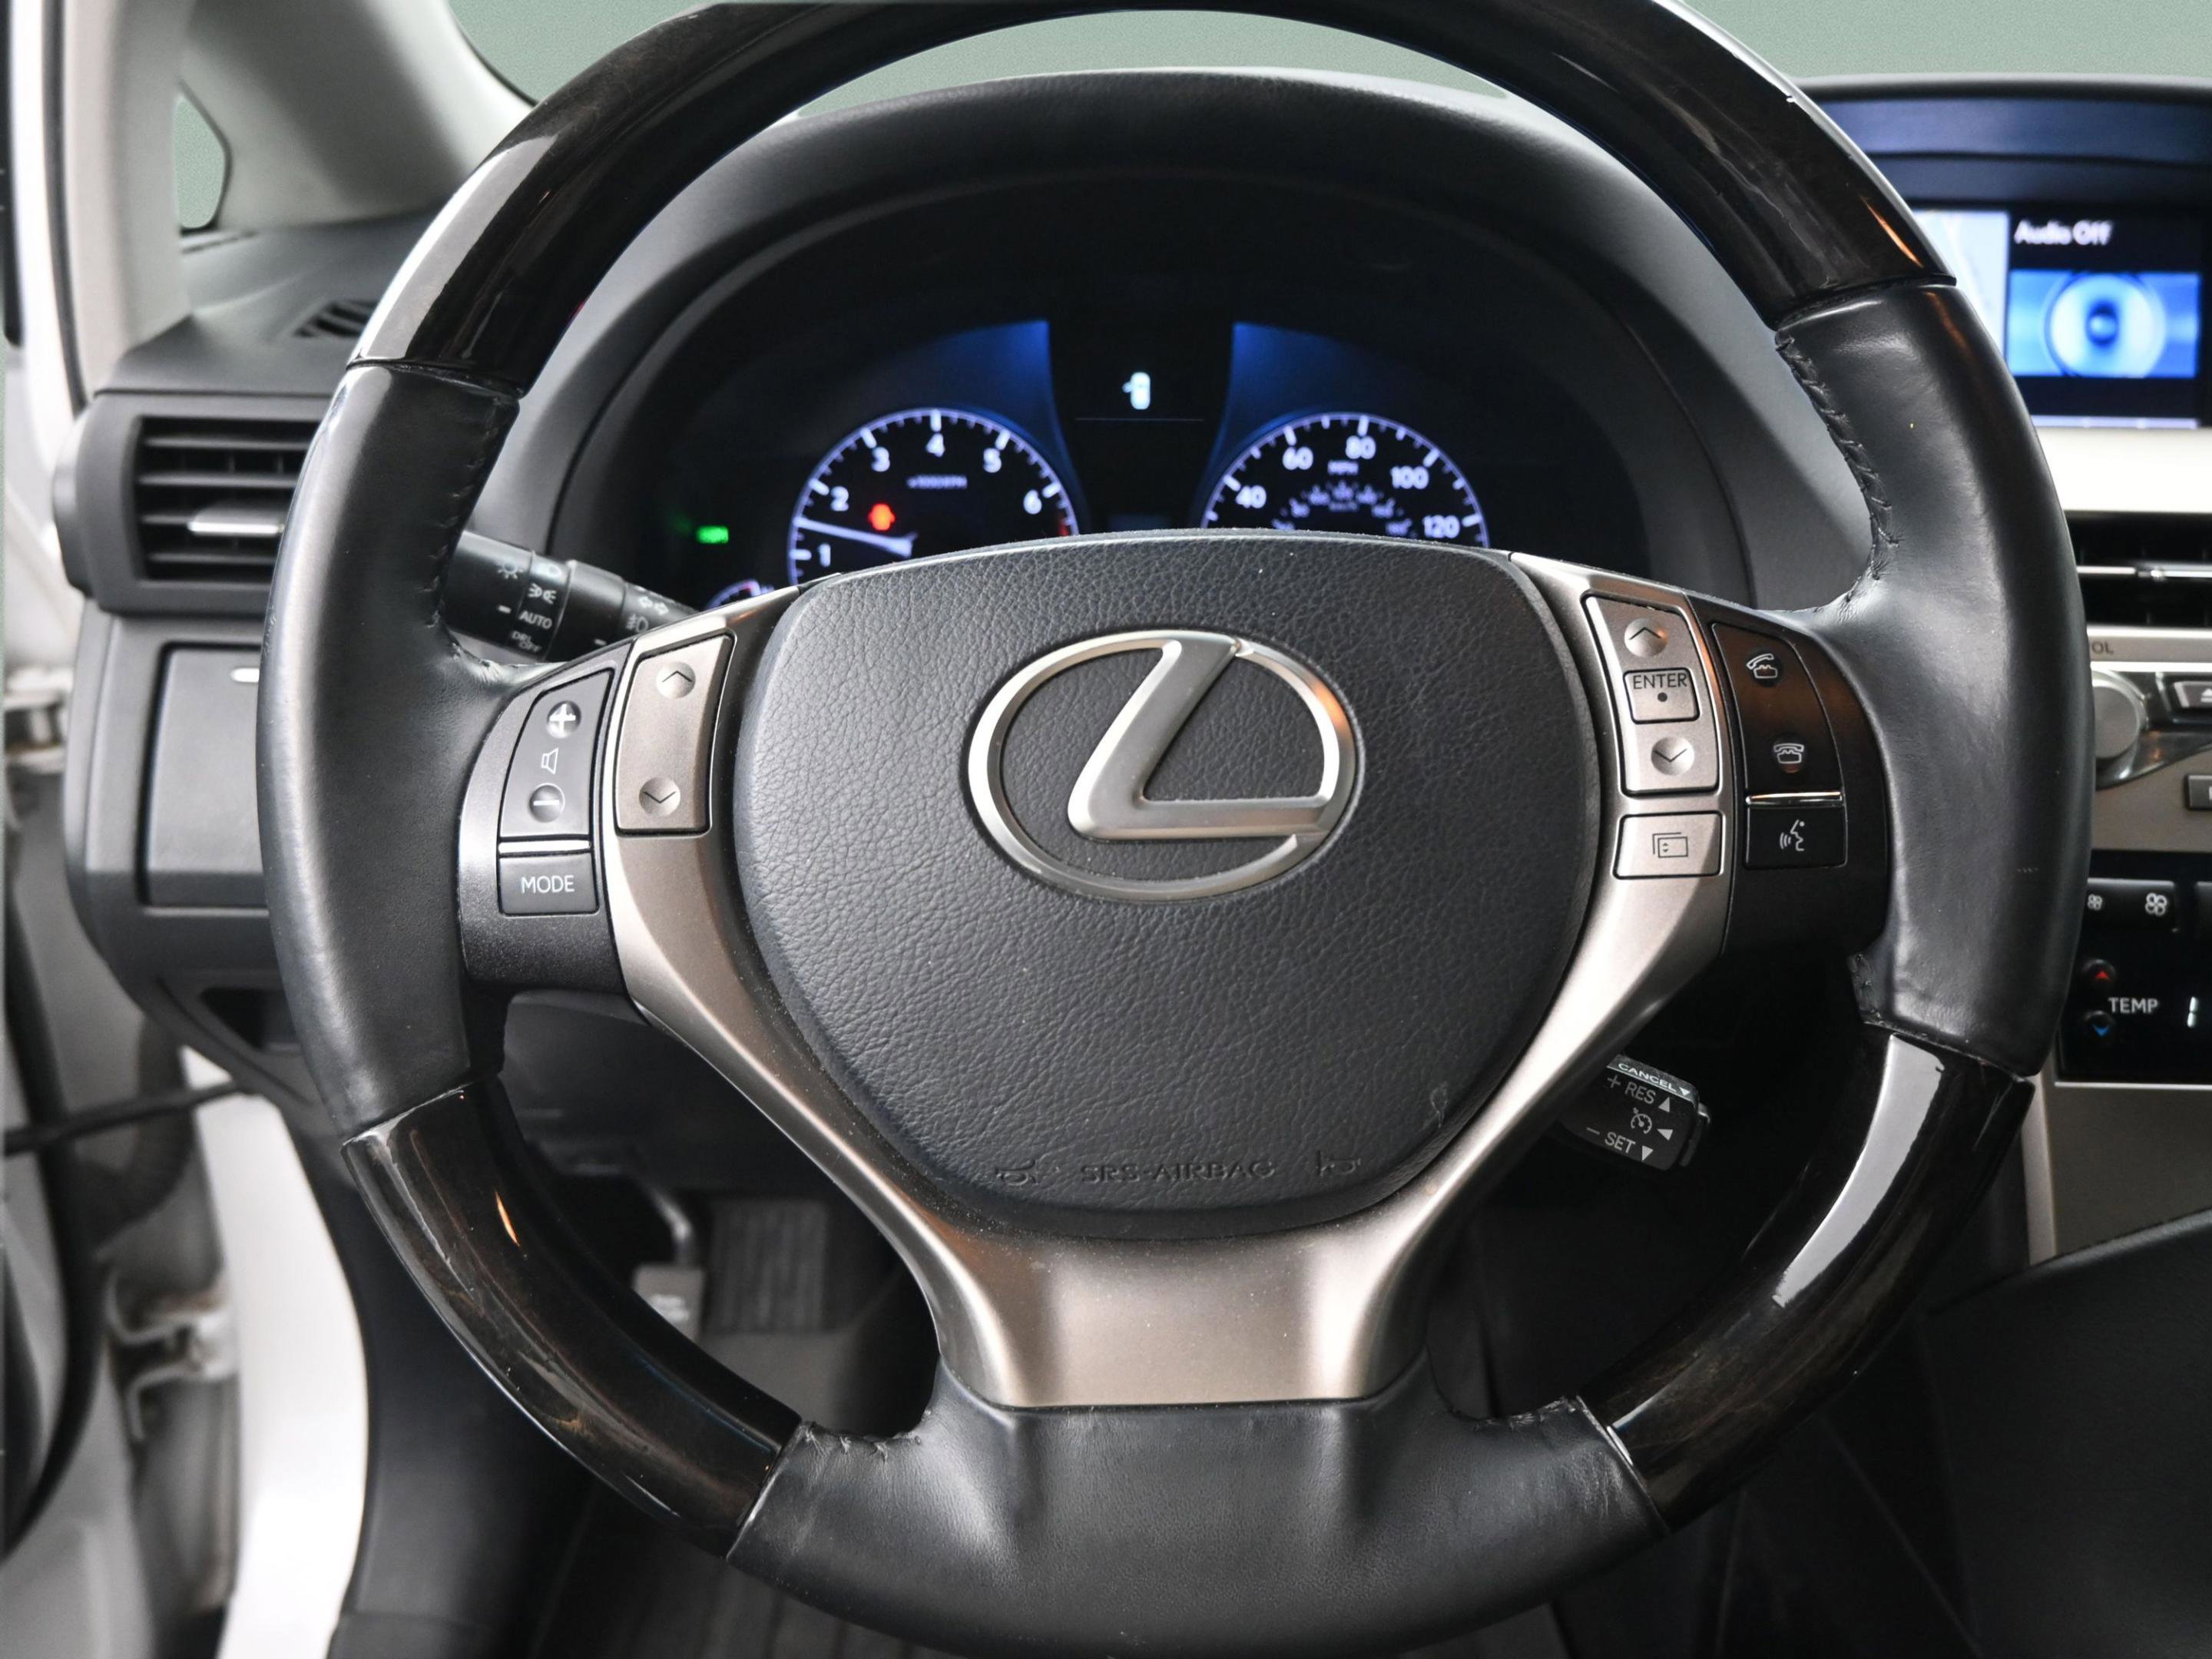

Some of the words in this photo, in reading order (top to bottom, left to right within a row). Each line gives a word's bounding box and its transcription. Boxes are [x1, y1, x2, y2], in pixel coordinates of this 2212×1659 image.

[2014, 219, 2072, 245] Audio
[2073, 219, 2113, 245] Off
[926, 432, 945, 457] 4
[1346, 435, 1376, 459] 80
[871, 446, 890, 472] 3
[1283, 447, 1313, 470] 60
[1390, 465, 1429, 490] 100
[830, 485, 849, 512] 2
[1023, 489, 1042, 514] 6
[1236, 485, 1267, 508] 40
[1423, 515, 1459, 538] 120
[818, 543, 831, 567] 1
[518, 610, 552, 630] AUTO
[2091, 641, 2114, 654] OL
[1633, 672, 1688, 690] ENTER
[521, 875, 575, 894] MODE
[2108, 998, 2158, 1014] TEMP
[1618, 1062, 1677, 1093] CANCEL
[1624, 1081, 1657, 1104] RES
[1604, 1131, 1636, 1154] SET
